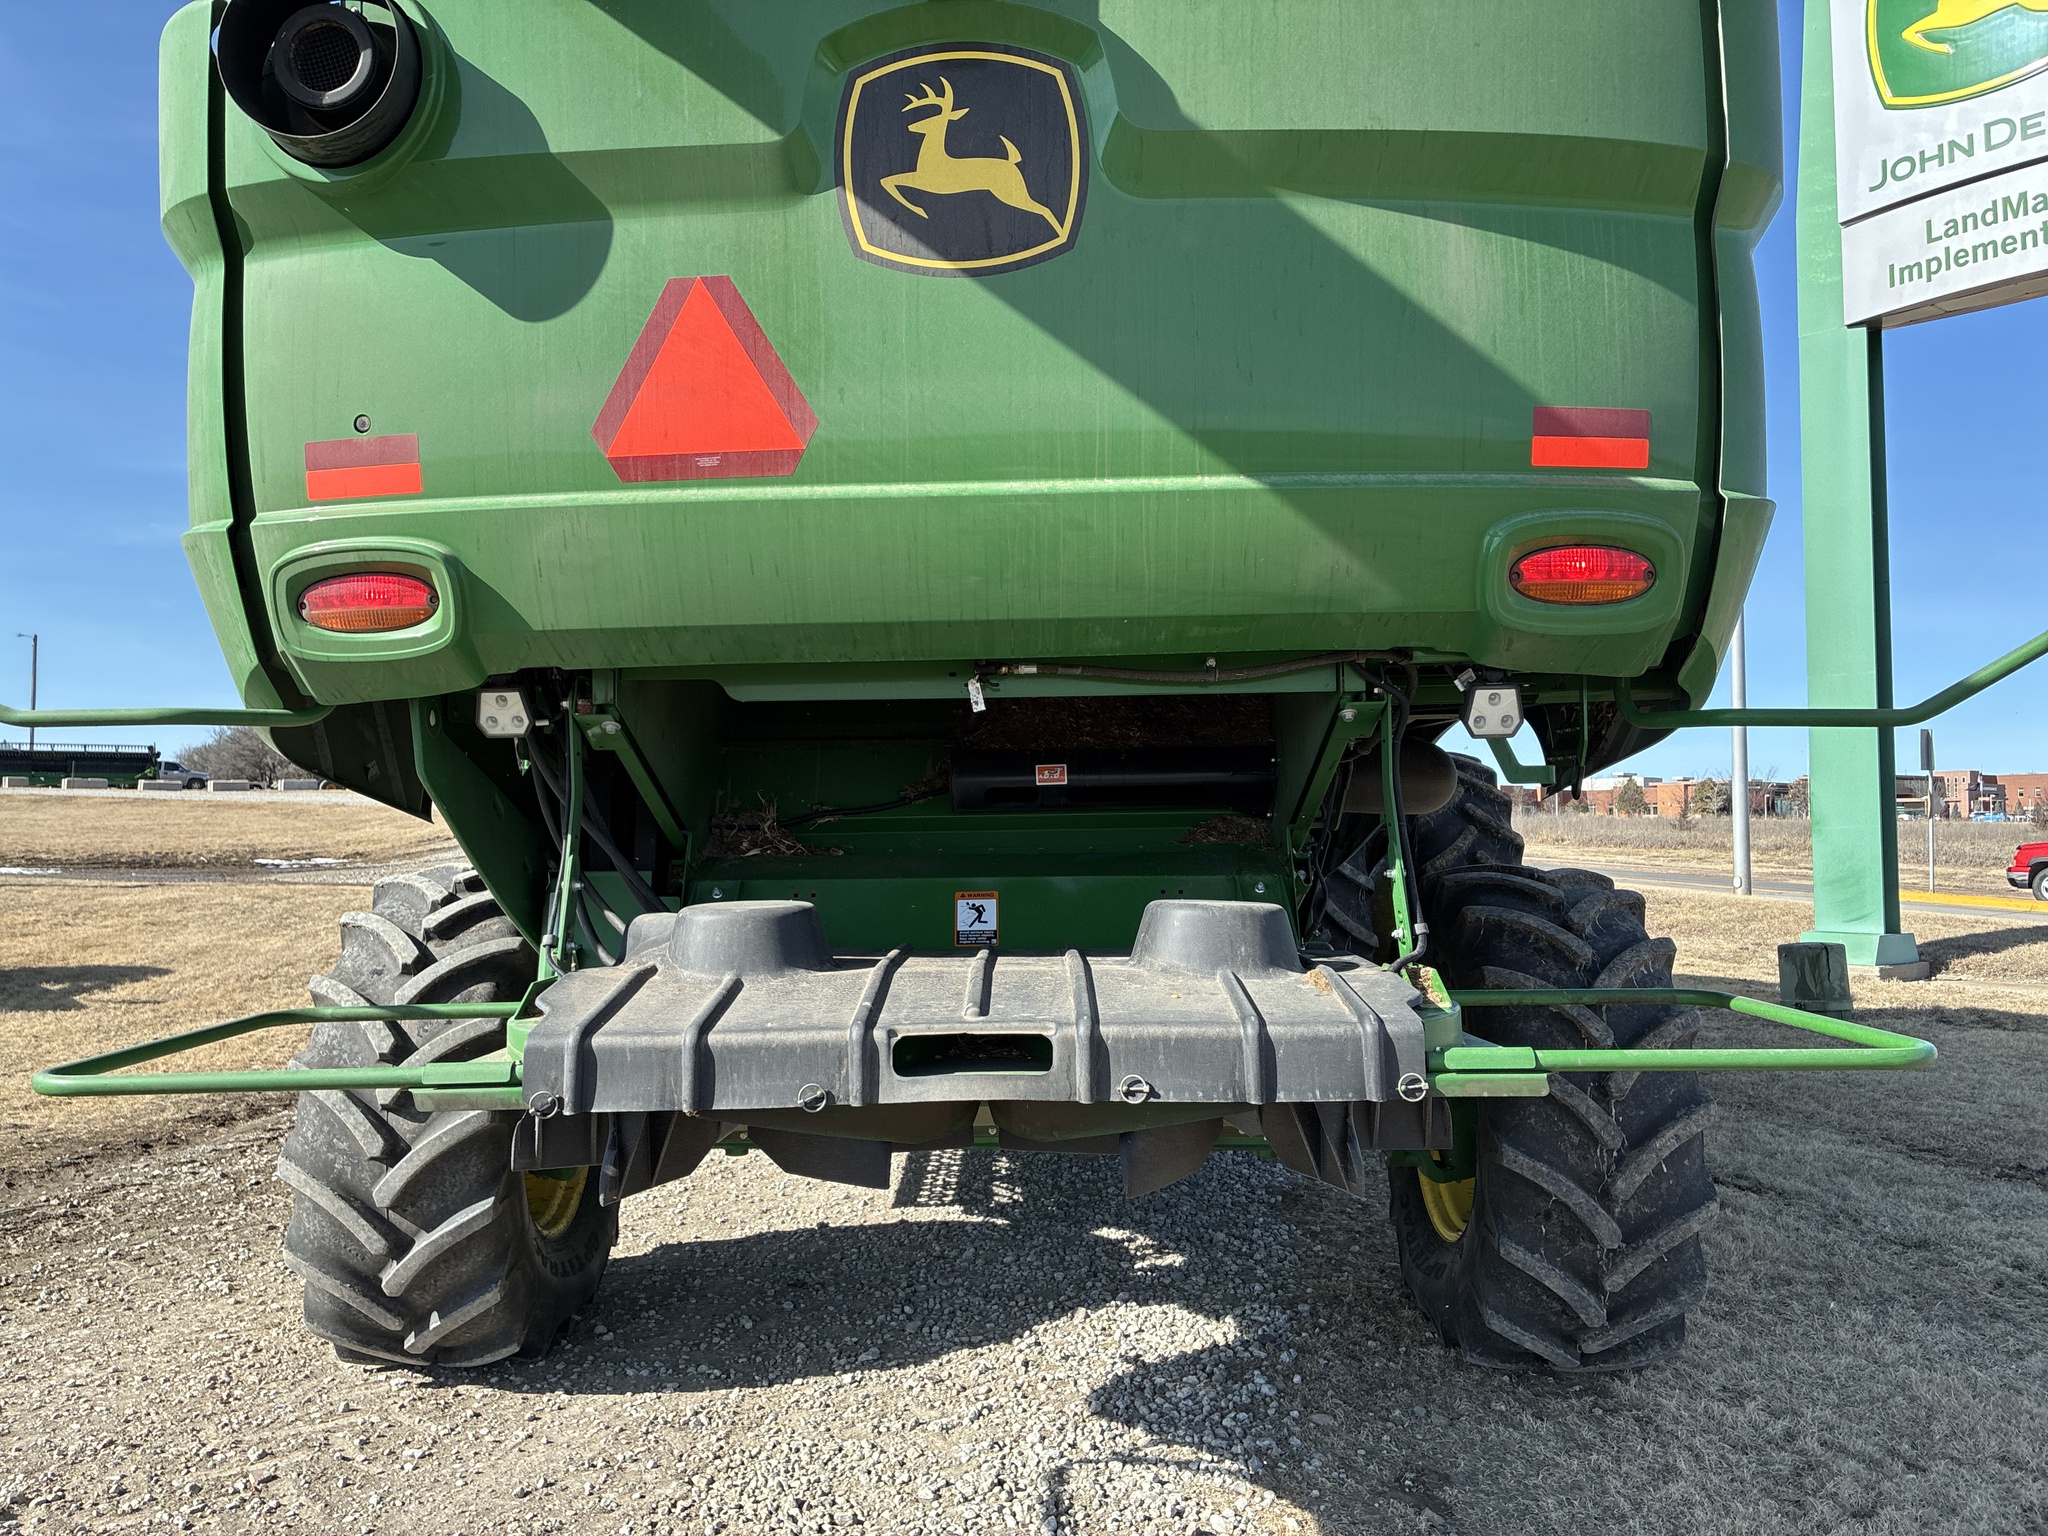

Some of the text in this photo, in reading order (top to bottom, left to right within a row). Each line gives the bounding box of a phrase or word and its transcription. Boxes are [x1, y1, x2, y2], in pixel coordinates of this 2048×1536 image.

[1868, 133, 1974, 192] JOHN
[1925, 190, 2048, 244] LandMa
[1888, 220, 2048, 288] Implement
